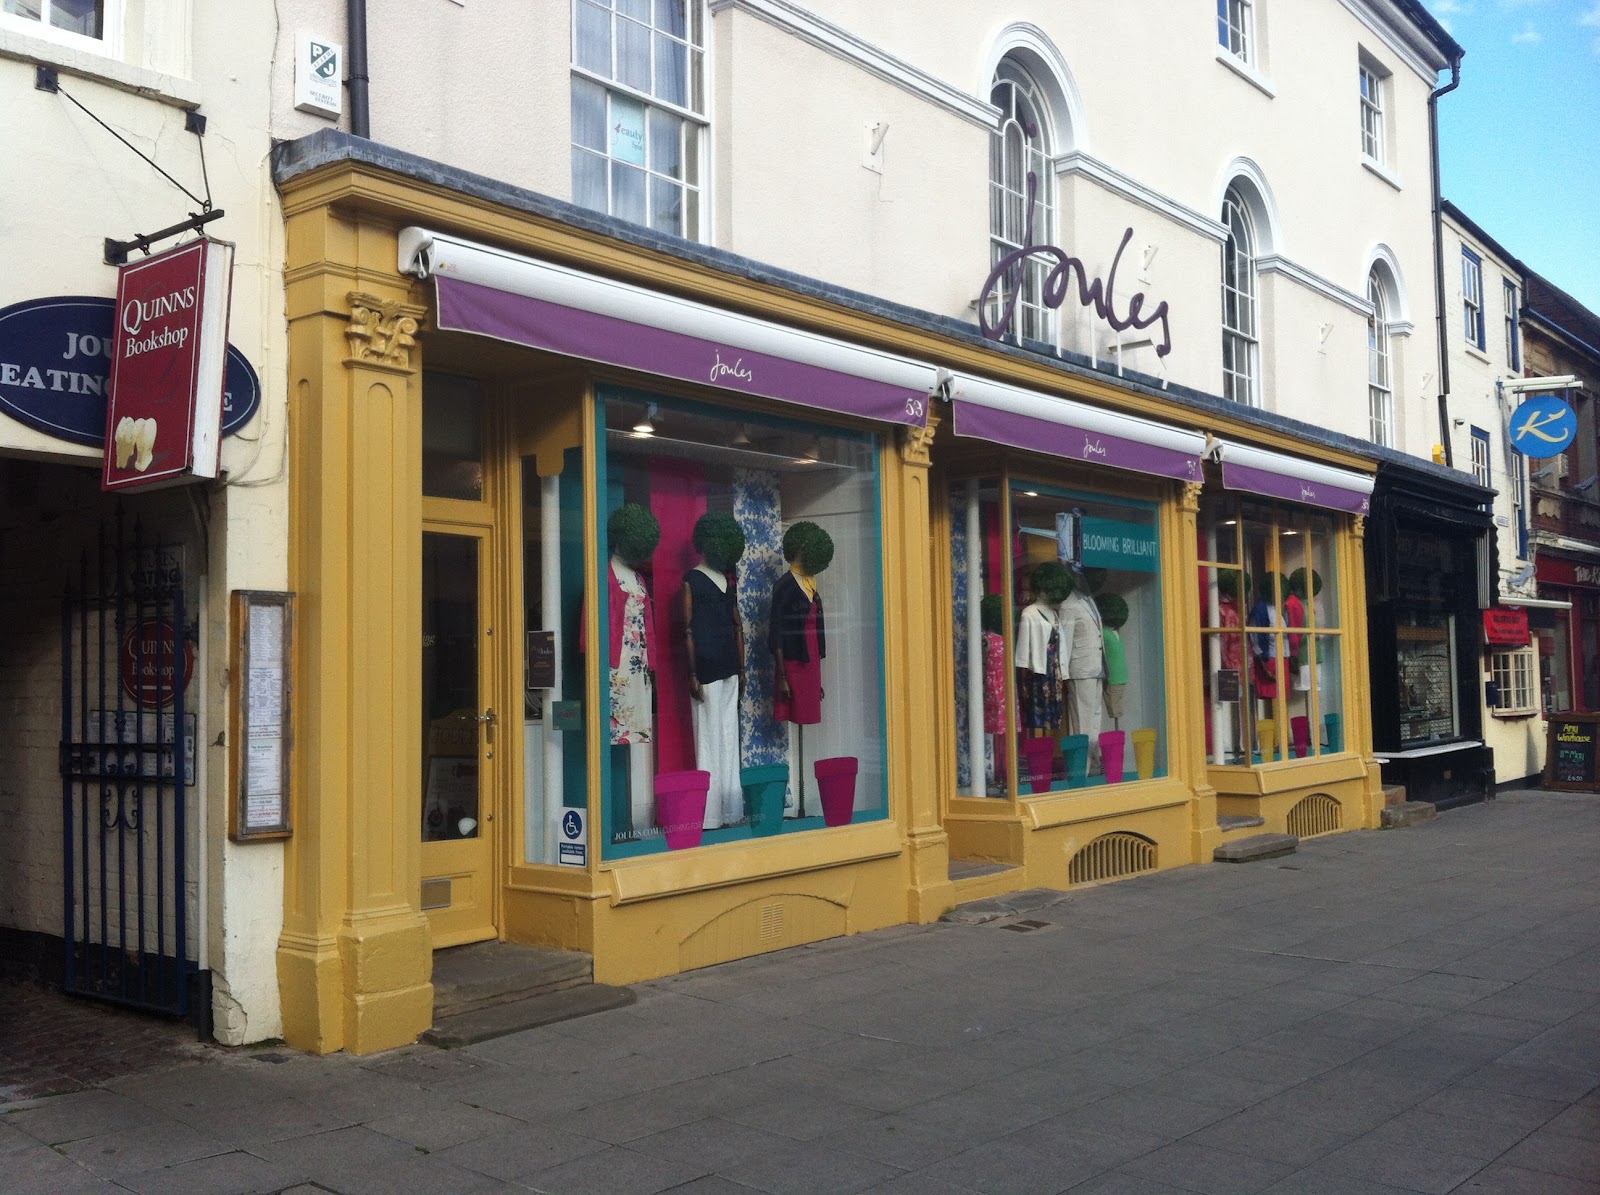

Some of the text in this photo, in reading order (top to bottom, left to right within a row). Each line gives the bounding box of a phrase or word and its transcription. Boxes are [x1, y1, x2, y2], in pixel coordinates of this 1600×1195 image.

[122, 286, 195, 335] QUINNS
[124, 326, 188, 358] Bookshop
[0, 362, 110, 397] EATIN
[905, 397, 923, 418] 53
[1516, 408, 1569, 443] K
[1083, 533, 1157, 557] BLOOMING BRILLIANT
